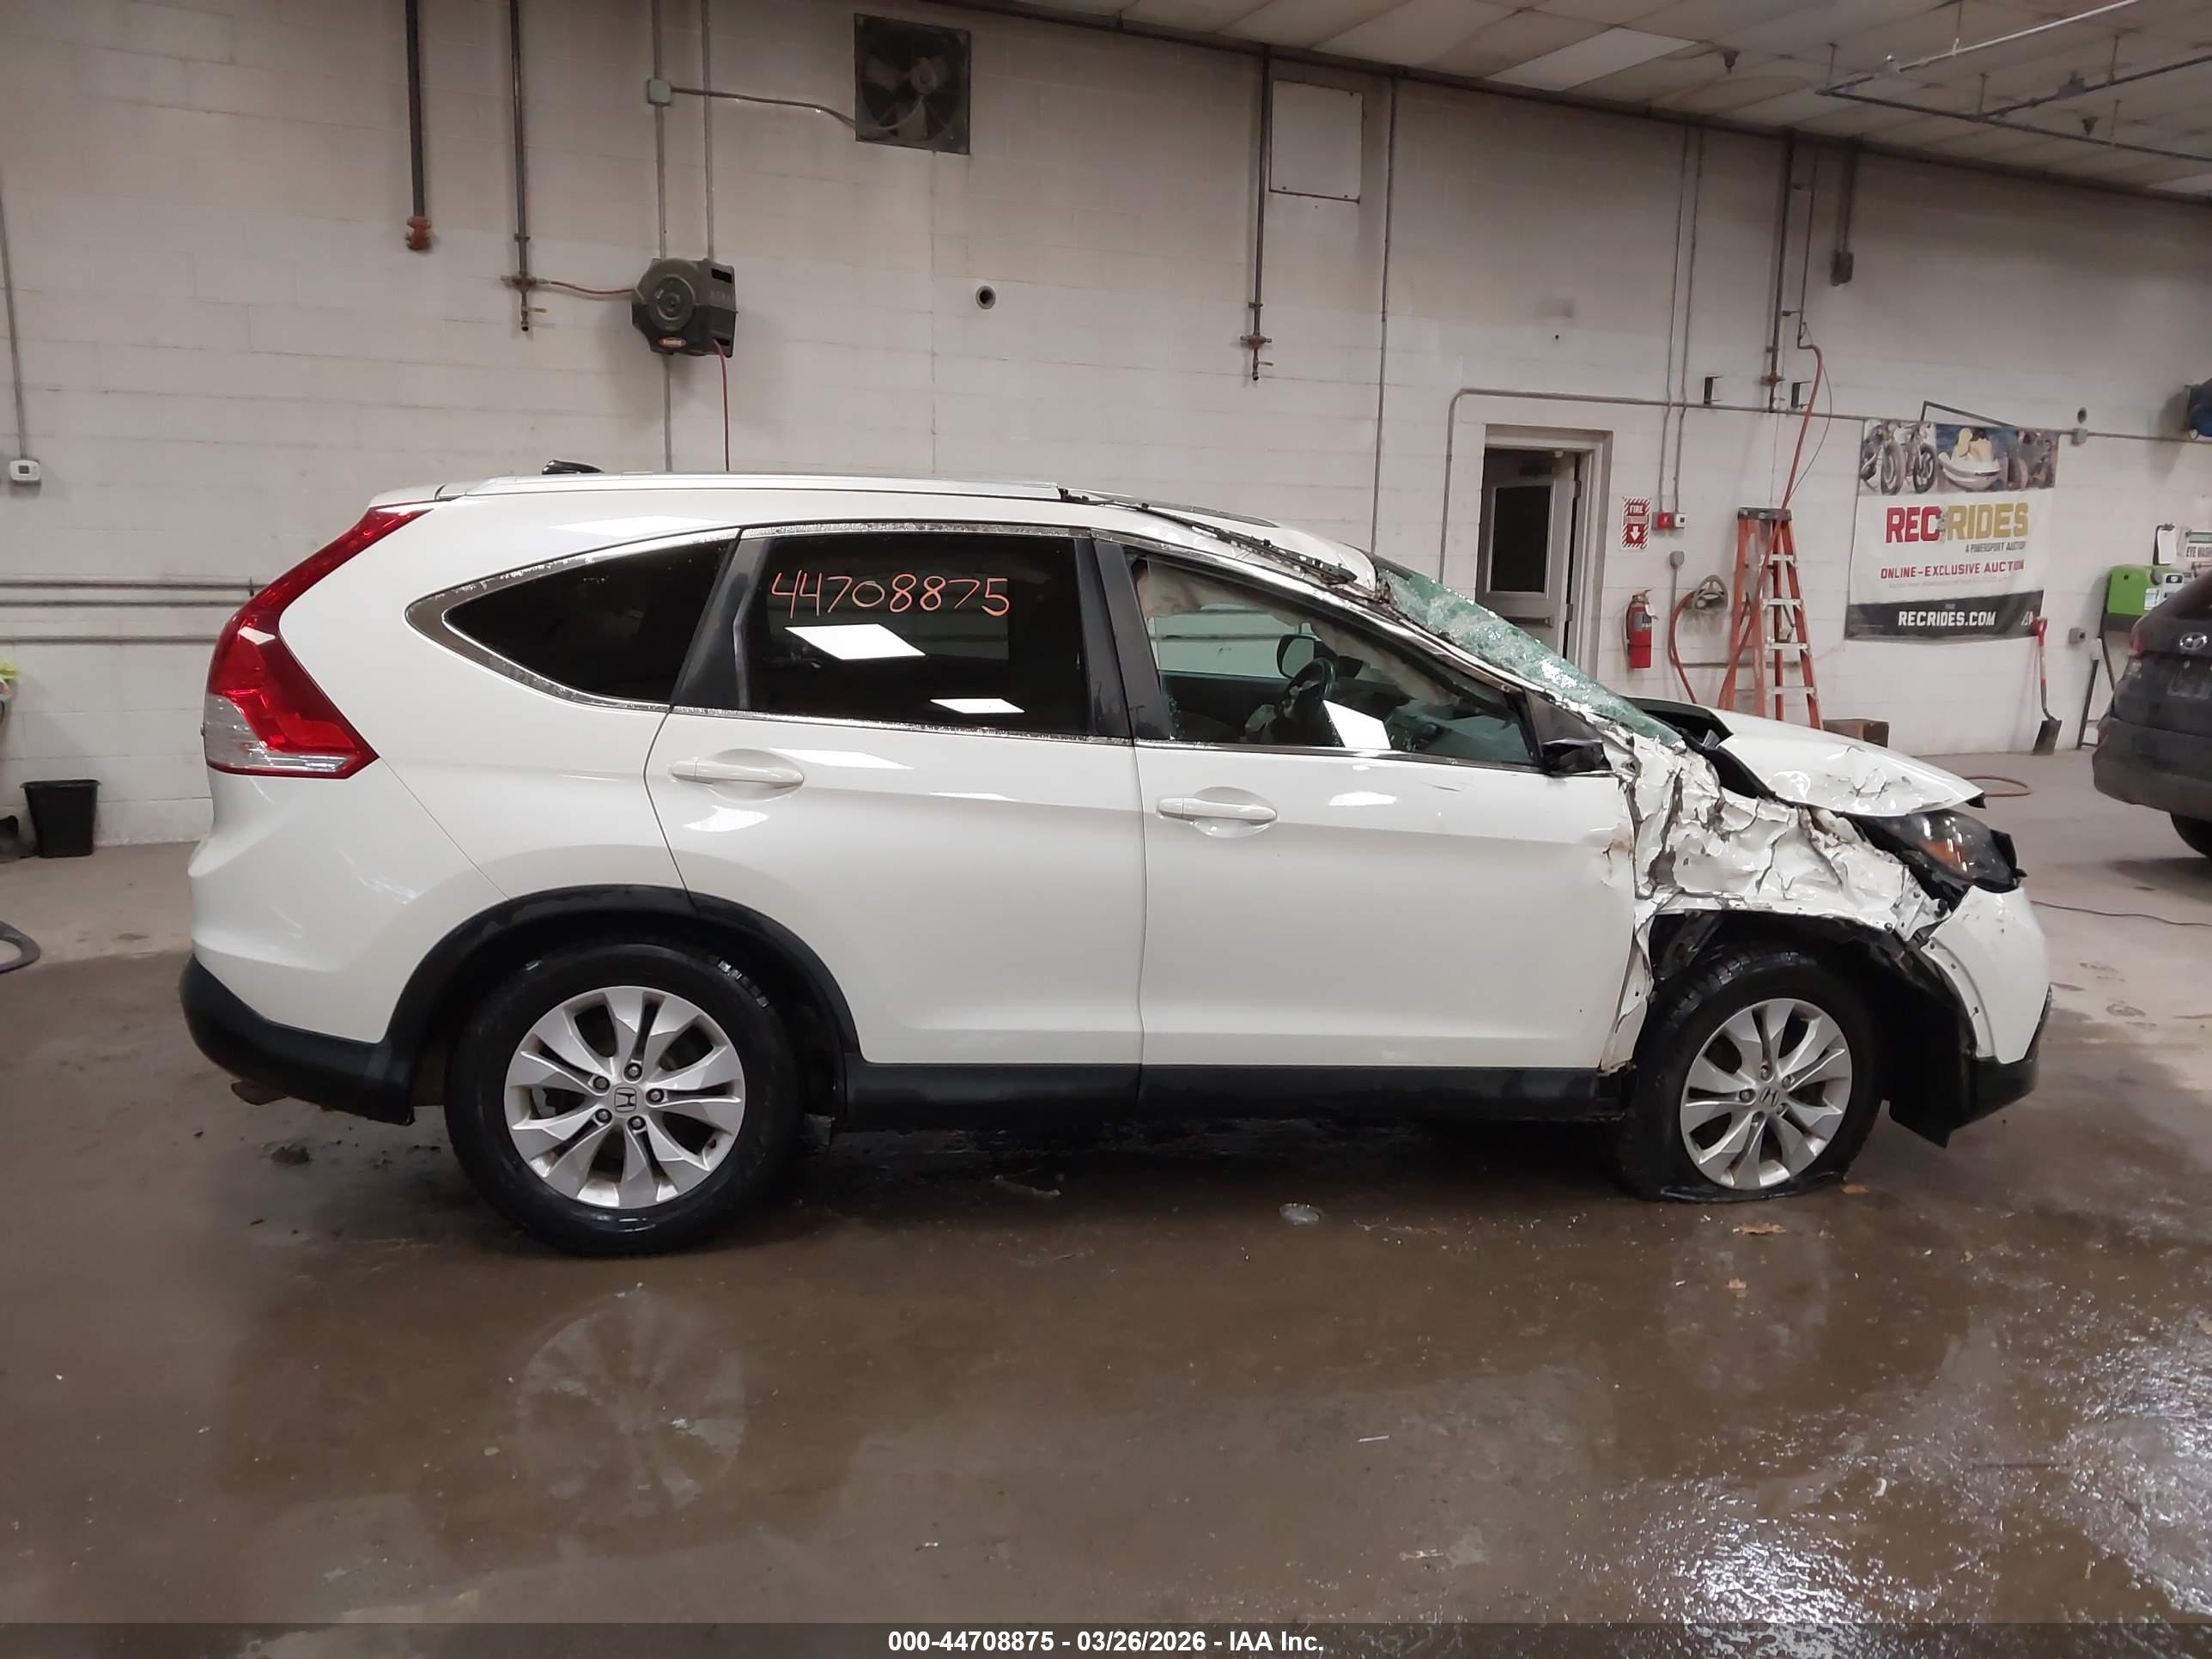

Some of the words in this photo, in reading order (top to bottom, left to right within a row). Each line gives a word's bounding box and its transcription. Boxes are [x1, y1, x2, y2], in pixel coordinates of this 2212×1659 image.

[1629, 504, 1644, 514] FIRE
[1886, 506, 1942, 543] REC
[1947, 502, 2029, 540] RIDES
[1881, 562, 1981, 580] ONLINE-EXCLUSIVE
[1984, 559, 2025, 573] AUCTION
[770, 569, 1010, 619] 44708875
[1898, 611, 1996, 627] RECRIDES.COM
